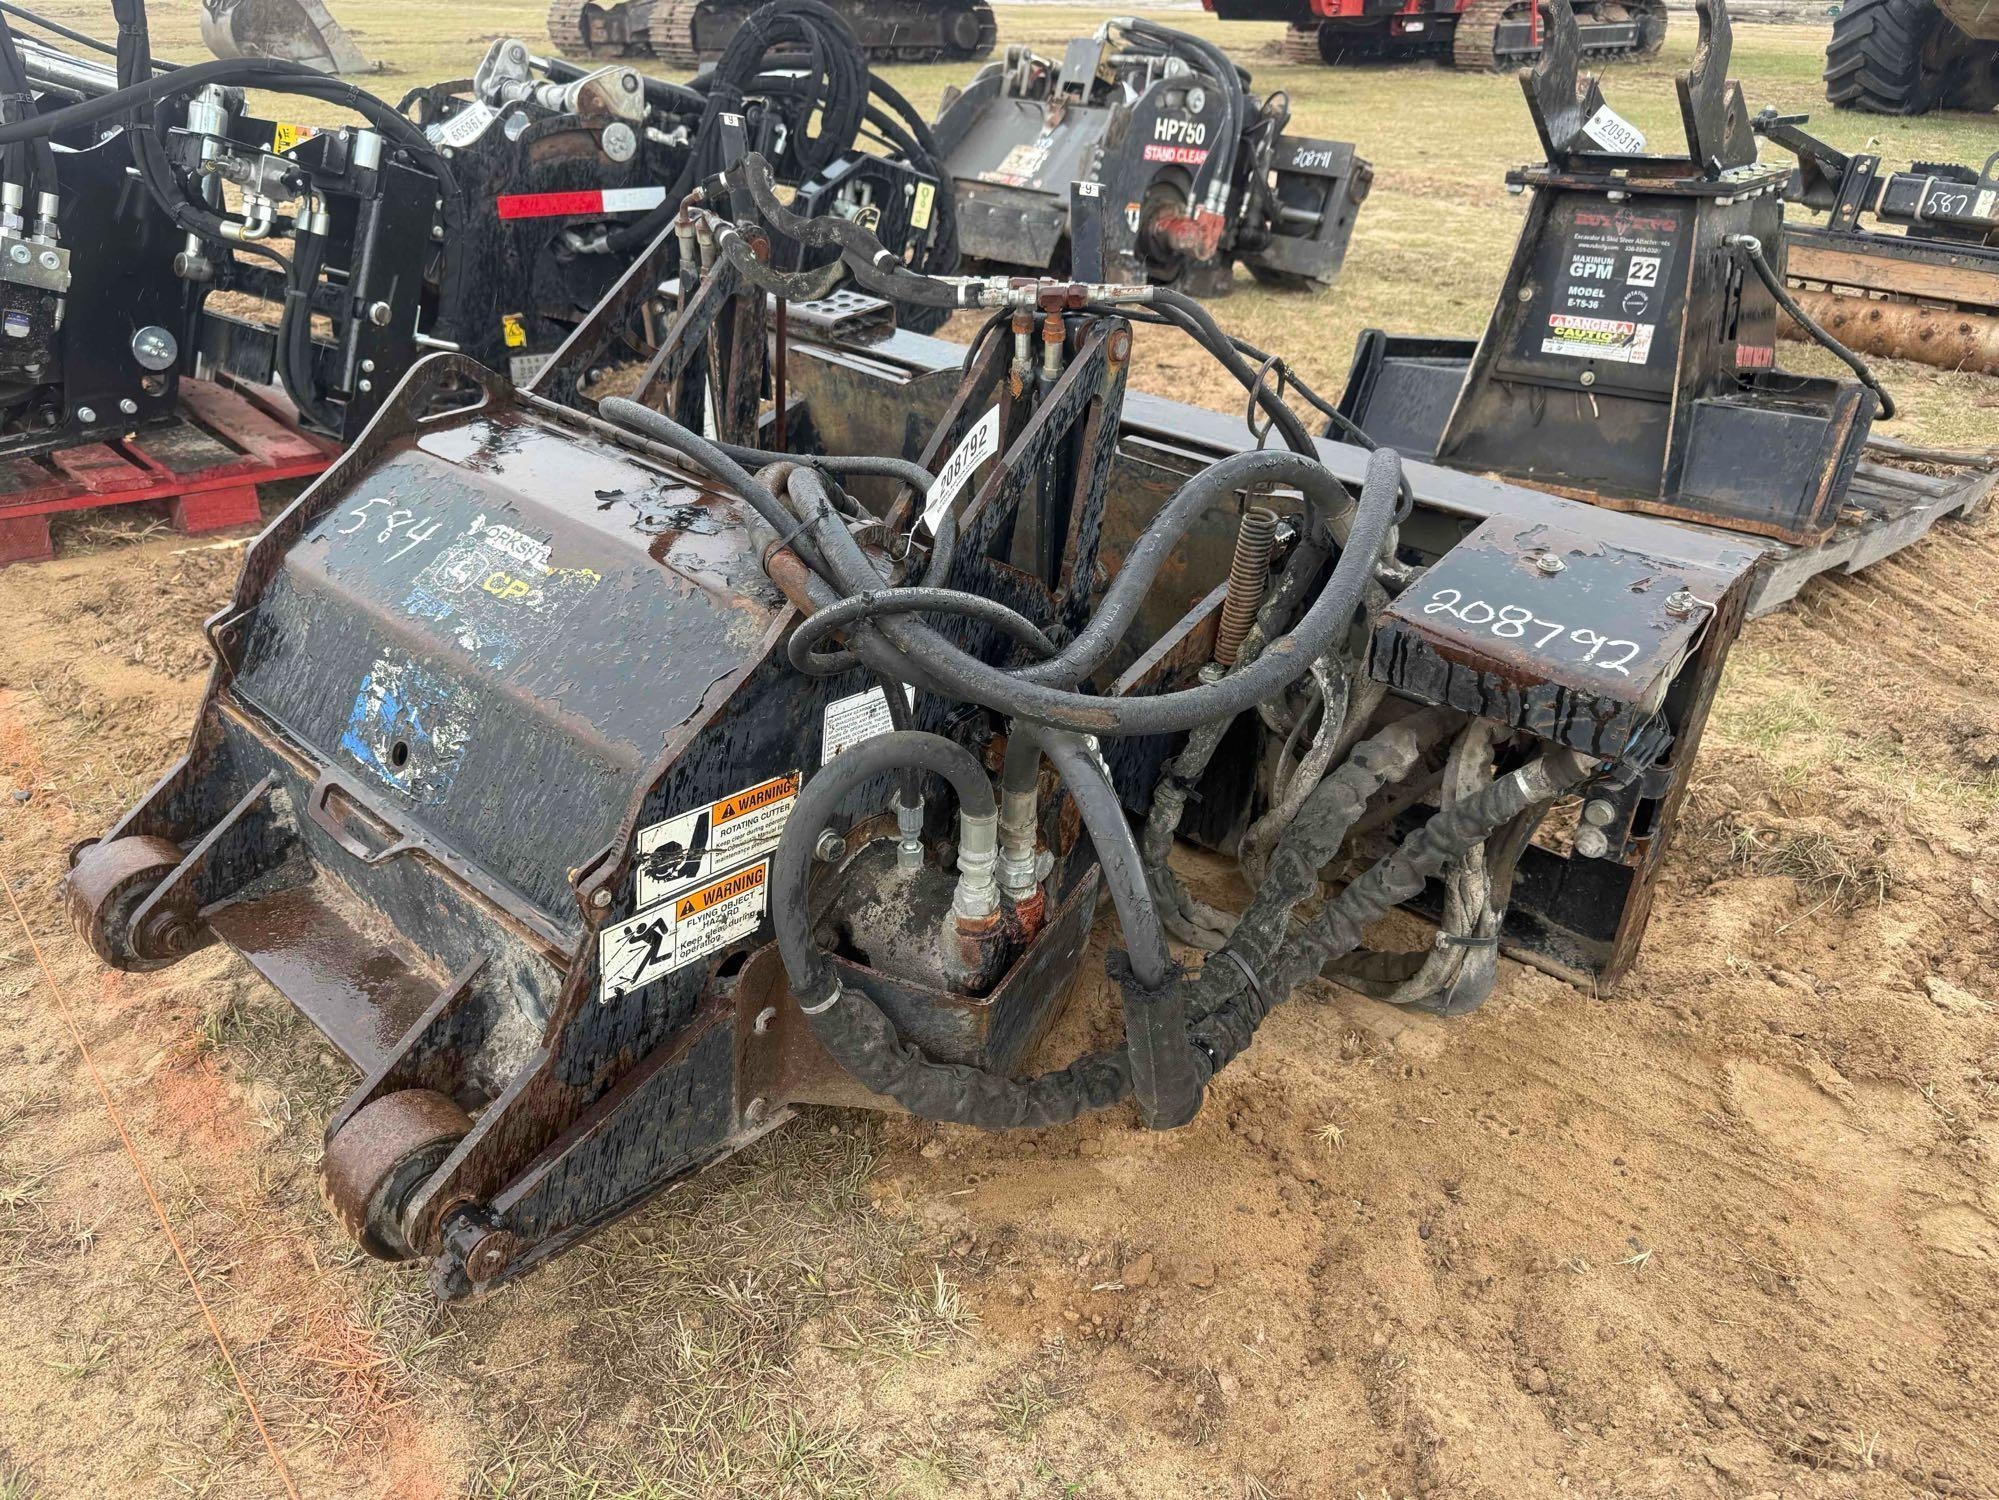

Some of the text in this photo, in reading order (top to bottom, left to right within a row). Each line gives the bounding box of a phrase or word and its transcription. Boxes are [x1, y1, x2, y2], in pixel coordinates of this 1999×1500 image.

[1154, 117, 1206, 145] HP750
[1602, 120, 1641, 153] 209315
[1144, 145, 1207, 164] STAND CLEAR
[1927, 191, 1968, 215] 587
[1570, 262, 1656, 280] GPM 22
[1573, 255, 1614, 265] MAXIMUM
[1568, 286, 1606, 297] MODEL
[1568, 299, 1599, 309] E-TS-36
[1565, 316, 1617, 332] DANGER
[939, 424, 988, 497] 208792
[338, 498, 442, 564] 584
[1424, 588, 1640, 677] 208792
[738, 781, 791, 811] WARNING
[720, 803, 790, 838] ROTATING CUTTER
[732, 833, 746, 843] clear
[747, 825, 764, 838] during
[765, 816, 787, 829] operatio
[703, 869, 763, 907] WARNING
[686, 891, 755, 928] FLYING OBJECT
[728, 911, 756, 928] during
